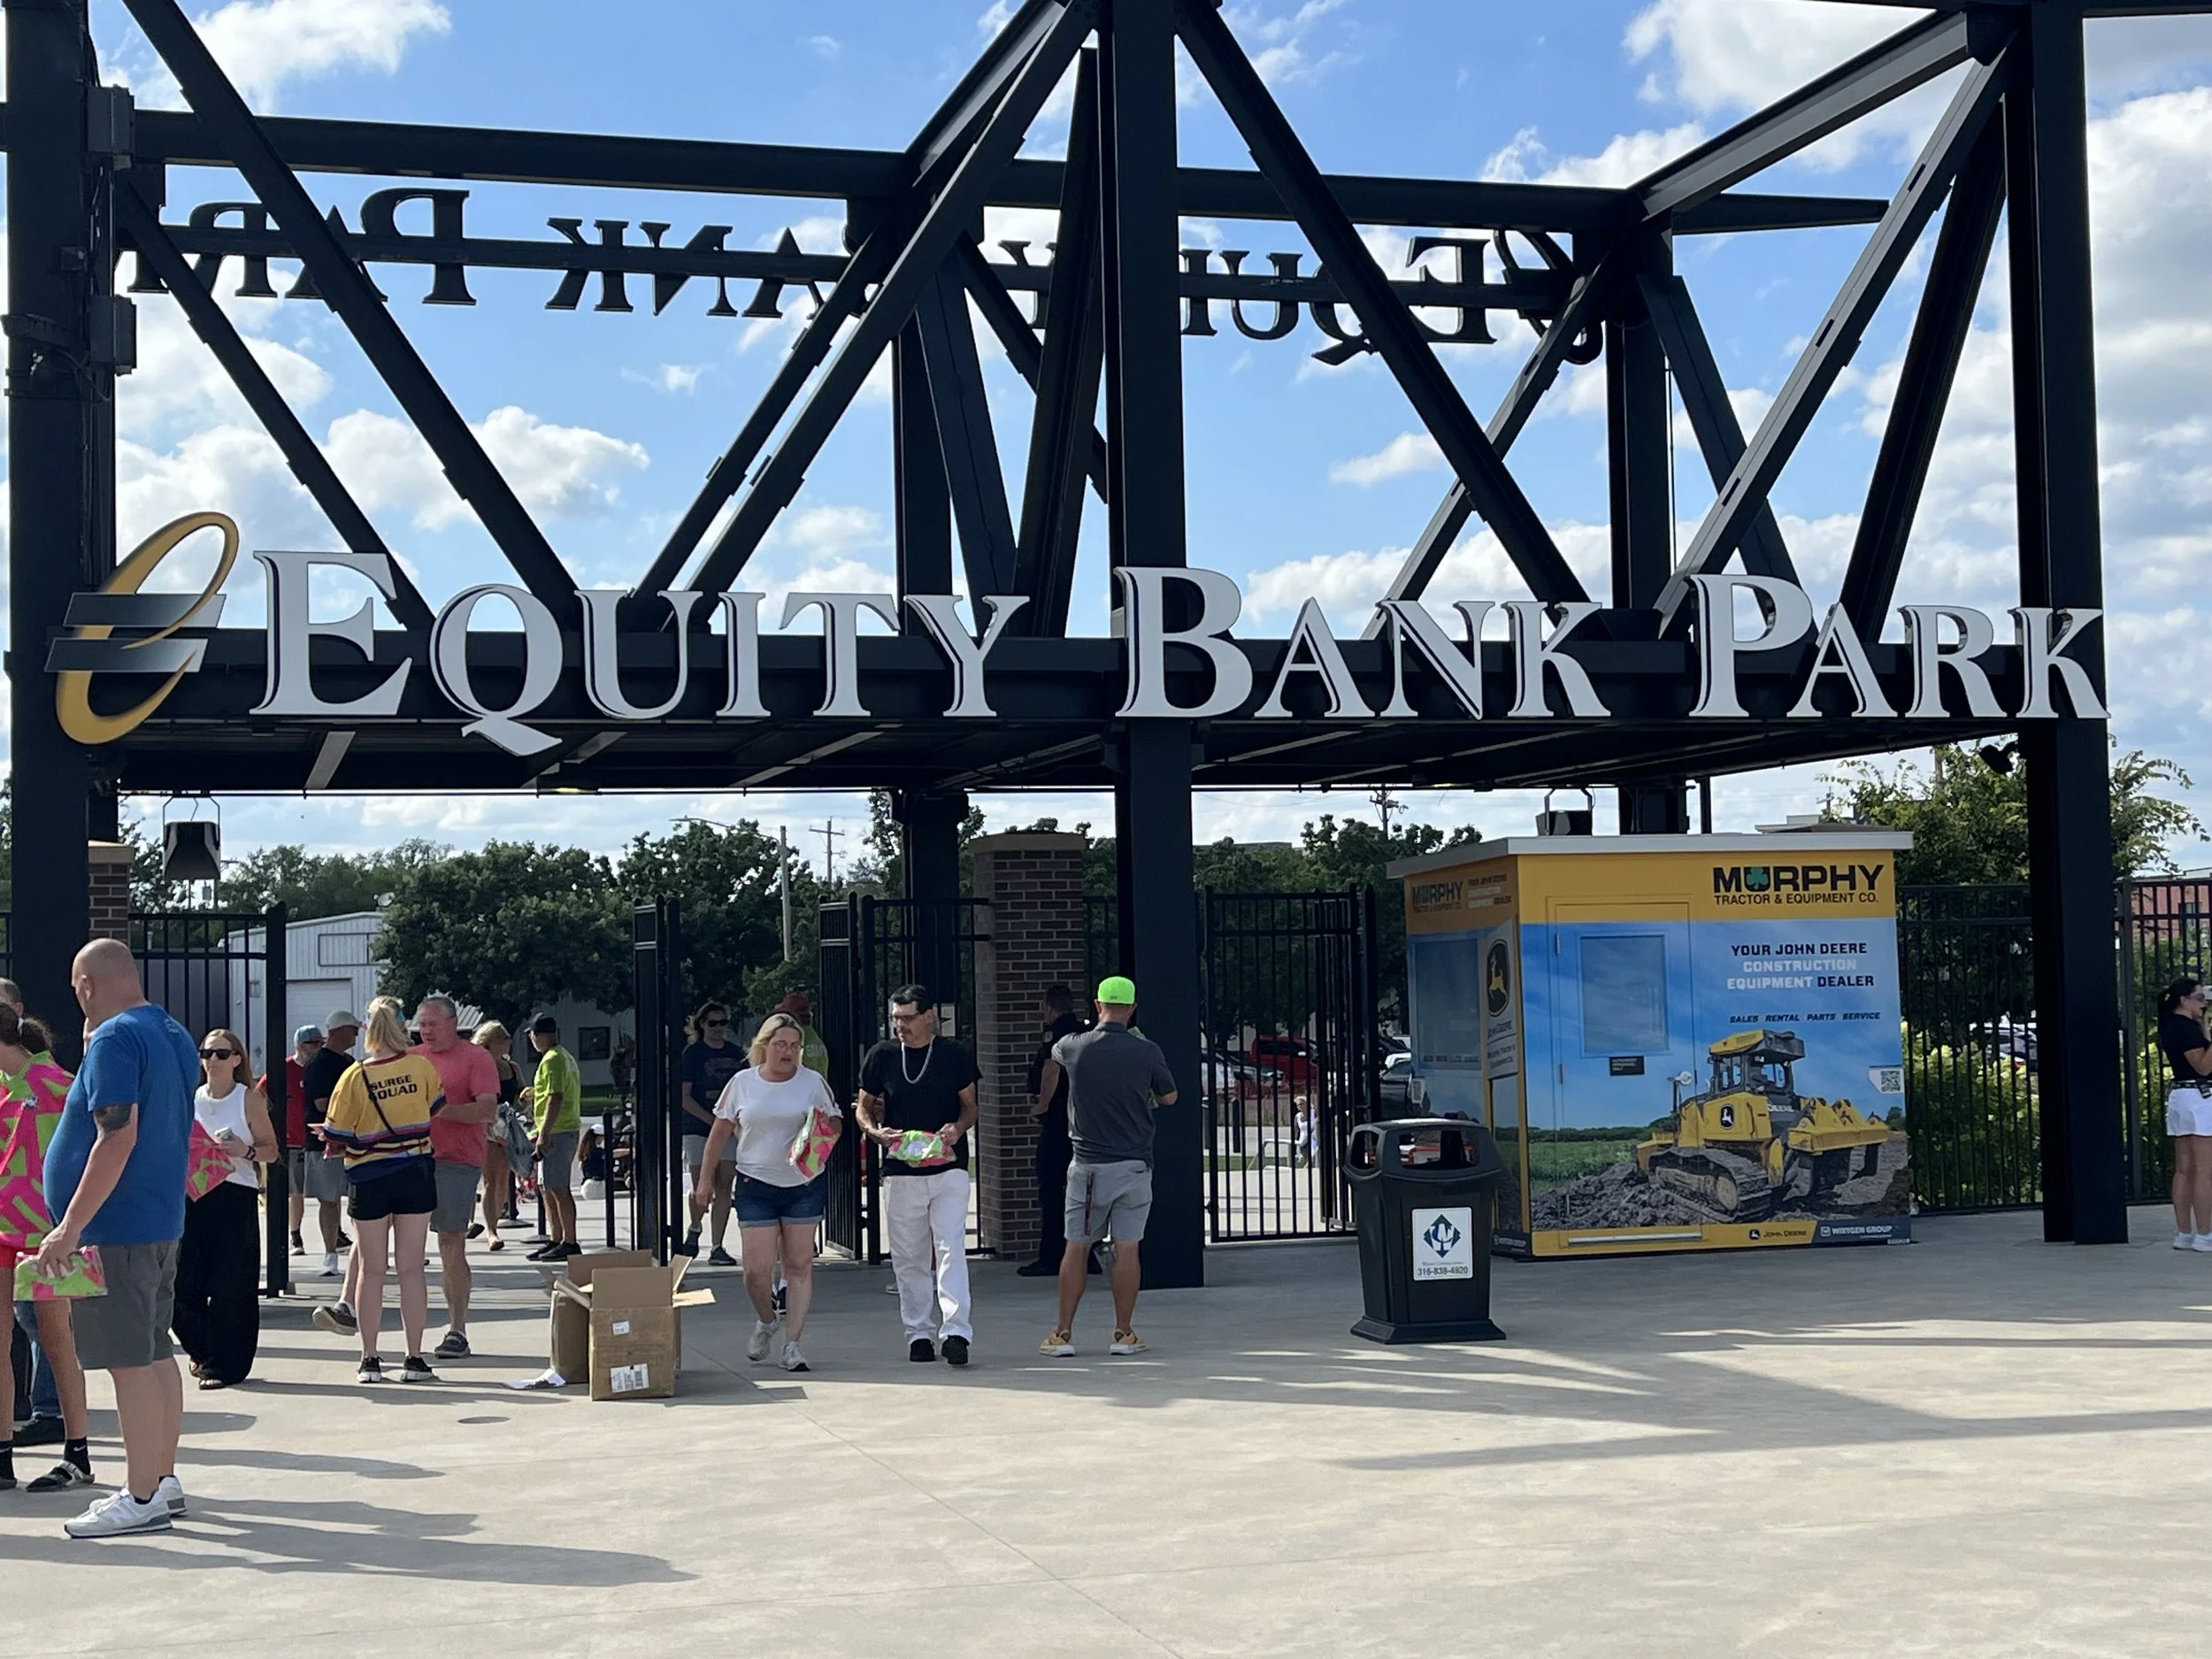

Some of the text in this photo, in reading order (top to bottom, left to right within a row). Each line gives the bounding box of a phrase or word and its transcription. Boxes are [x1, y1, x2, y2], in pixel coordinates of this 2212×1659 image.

[250, 550, 1030, 757] EQUITY
[1113, 566, 1610, 719] BANK
[1688, 574, 2110, 719] PARK
[1713, 864, 1884, 893] MURPHY
[1715, 892, 1878, 905] TRACTOR & EQUIPMENT CO.
[1732, 943, 1867, 956] YOUR JOHN DEERE
[1743, 959, 1857, 972] CONSTRUCTION
[1727, 976, 1874, 990] EQUIPMENT DEALER
[371, 1074, 412, 1091] SURGE
[372, 1084, 417, 1100] QUAD
